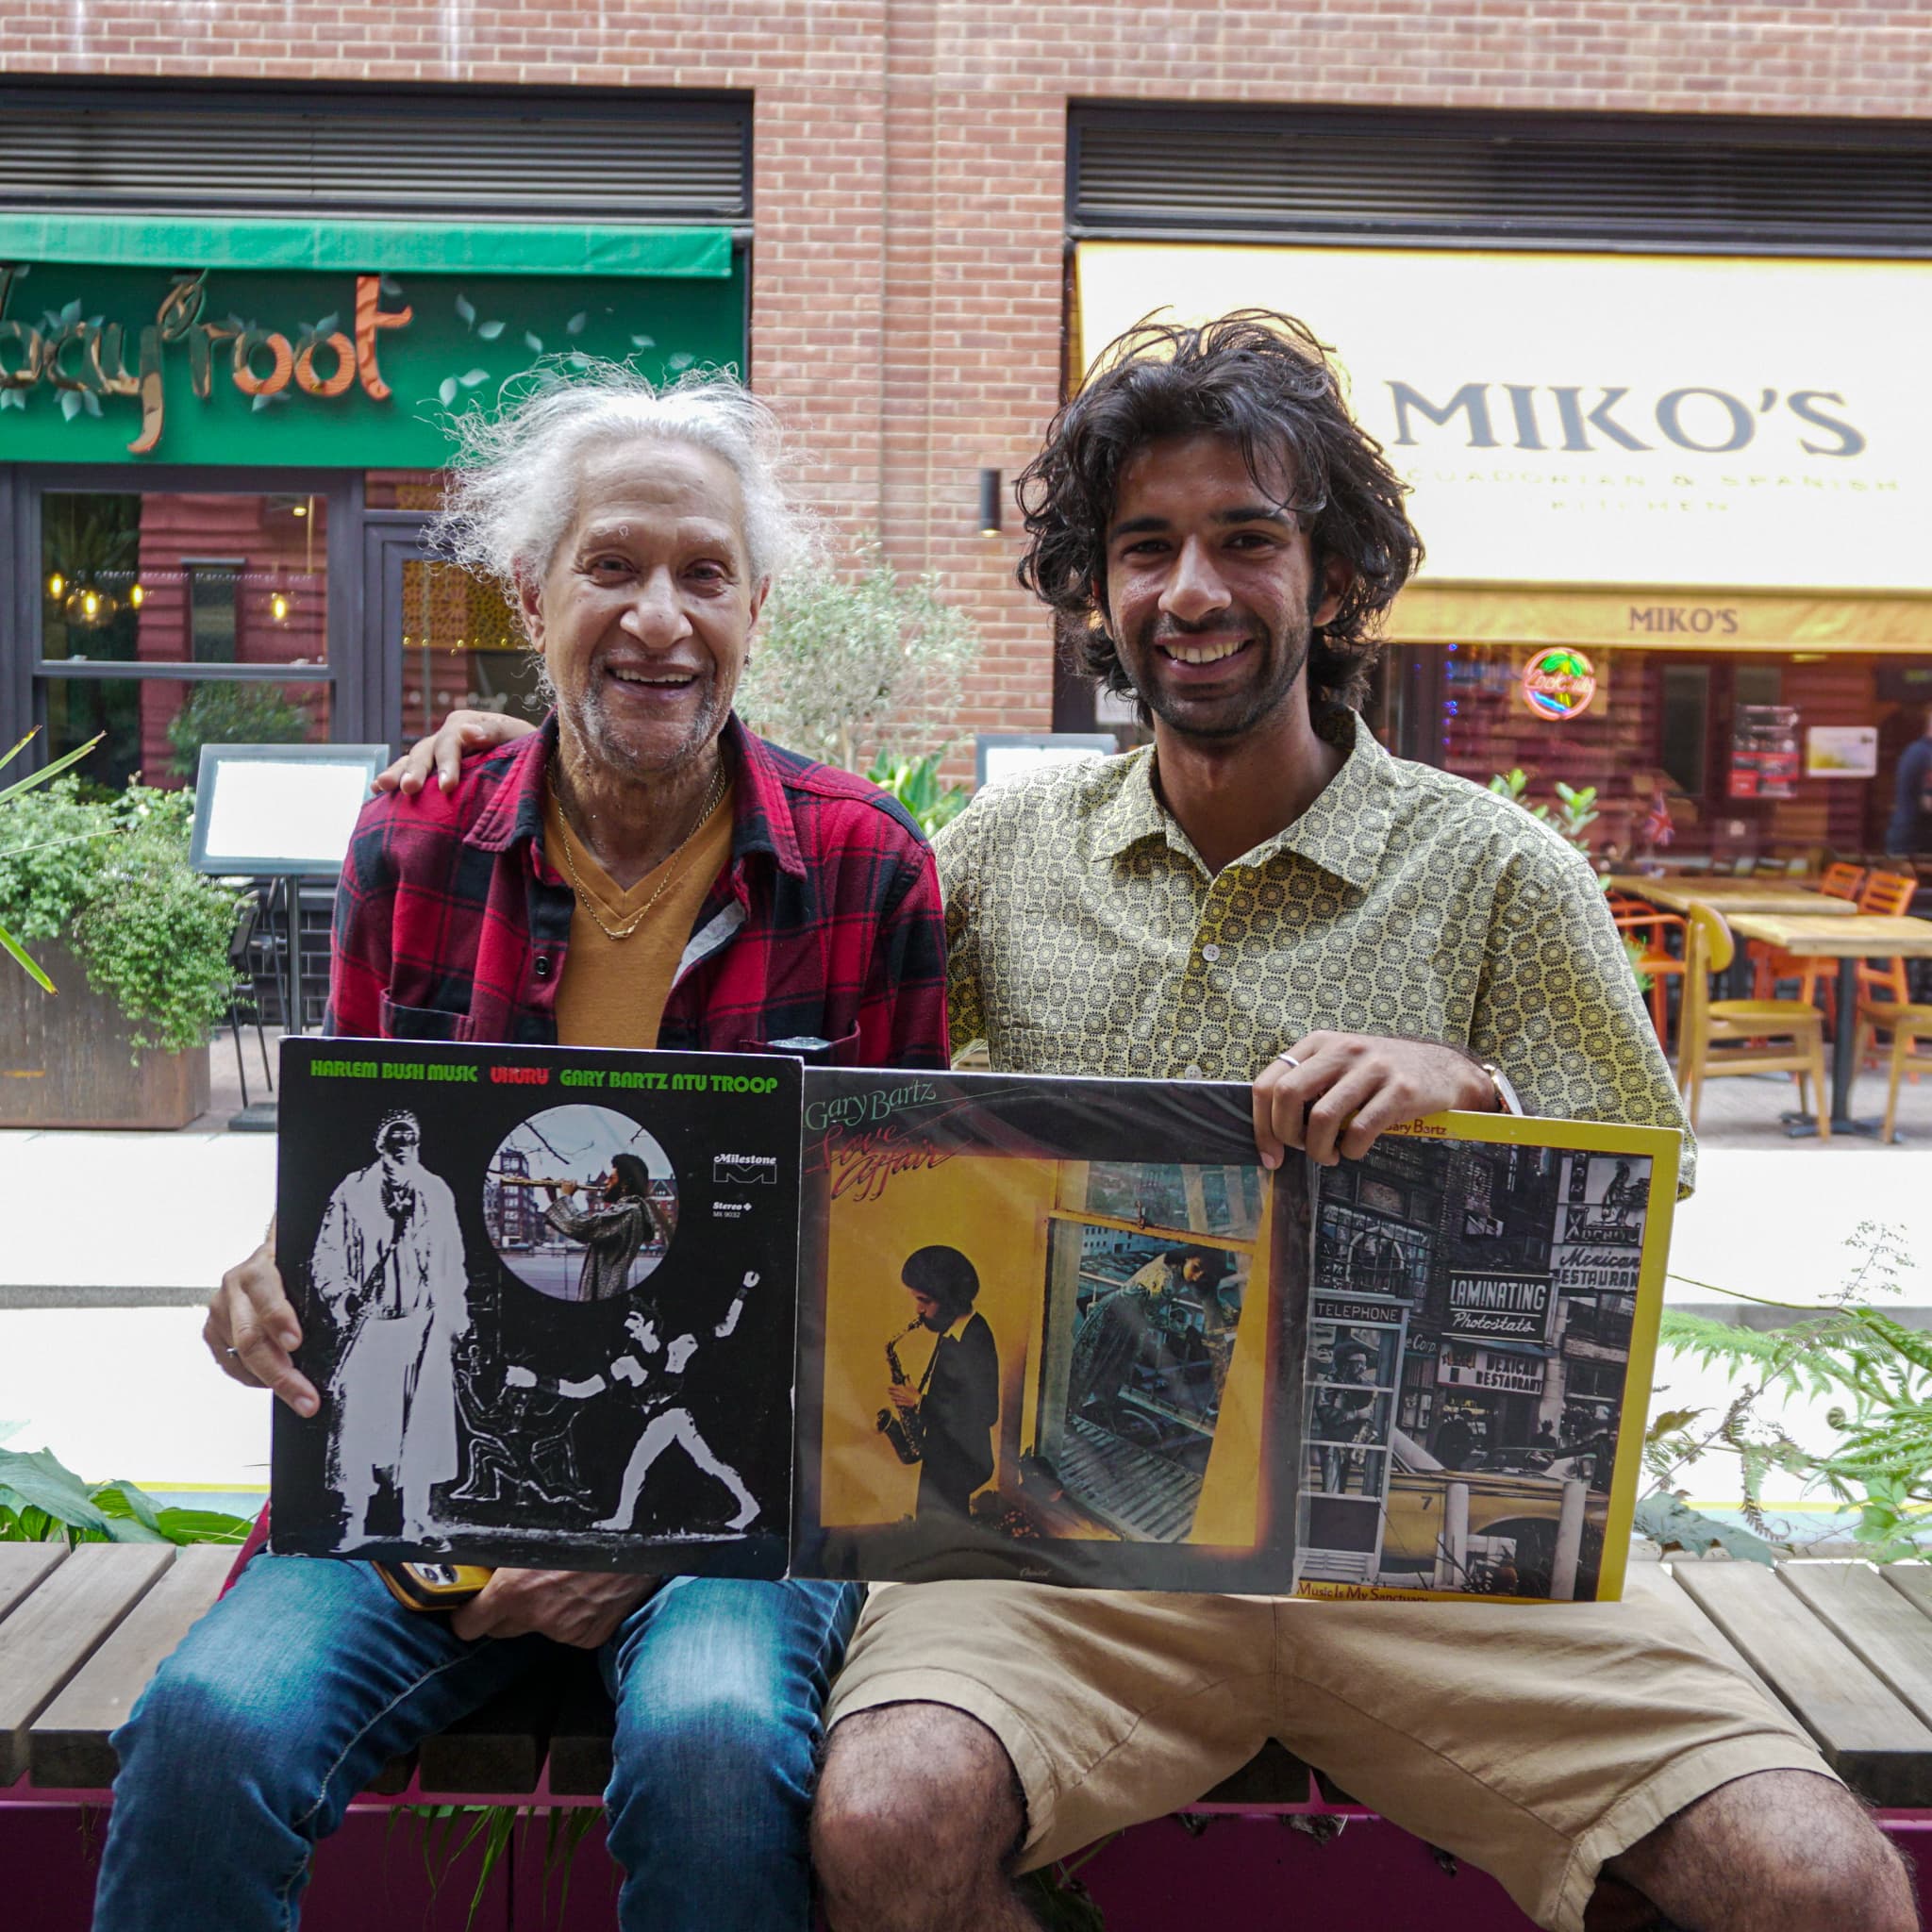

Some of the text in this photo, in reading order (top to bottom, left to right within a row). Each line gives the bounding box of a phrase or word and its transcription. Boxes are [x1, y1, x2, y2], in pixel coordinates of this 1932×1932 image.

[1384, 379, 1867, 458] MIKO'S
[1628, 607, 1739, 634] MIKO'S
[309, 1058, 378, 1079] HARLEM
[380, 1061, 425, 1081] BUSH
[426, 1062, 478, 1083] MUSIC
[558, 1069, 606, 1088] GARY
[608, 1070, 669, 1091] BARTZ
[708, 1074, 778, 1094] TROOP
[805, 1078, 937, 1131] Gary Bartz
[1413, 1119, 1447, 1136] Bartz
[713, 1153, 777, 1165] Milestone
[804, 1124, 900, 1175] Love
[712, 1201, 742, 1211] Stereo
[1449, 1278, 1547, 1311] LAMINATING
[1317, 1302, 1398, 1322] TELEPHONE
[1454, 1311, 1537, 1333] Photostats
[1421, 1495, 1433, 1511] 7
[1297, 1581, 1333, 1597] Music
[1334, 1584, 1344, 1599] Is
